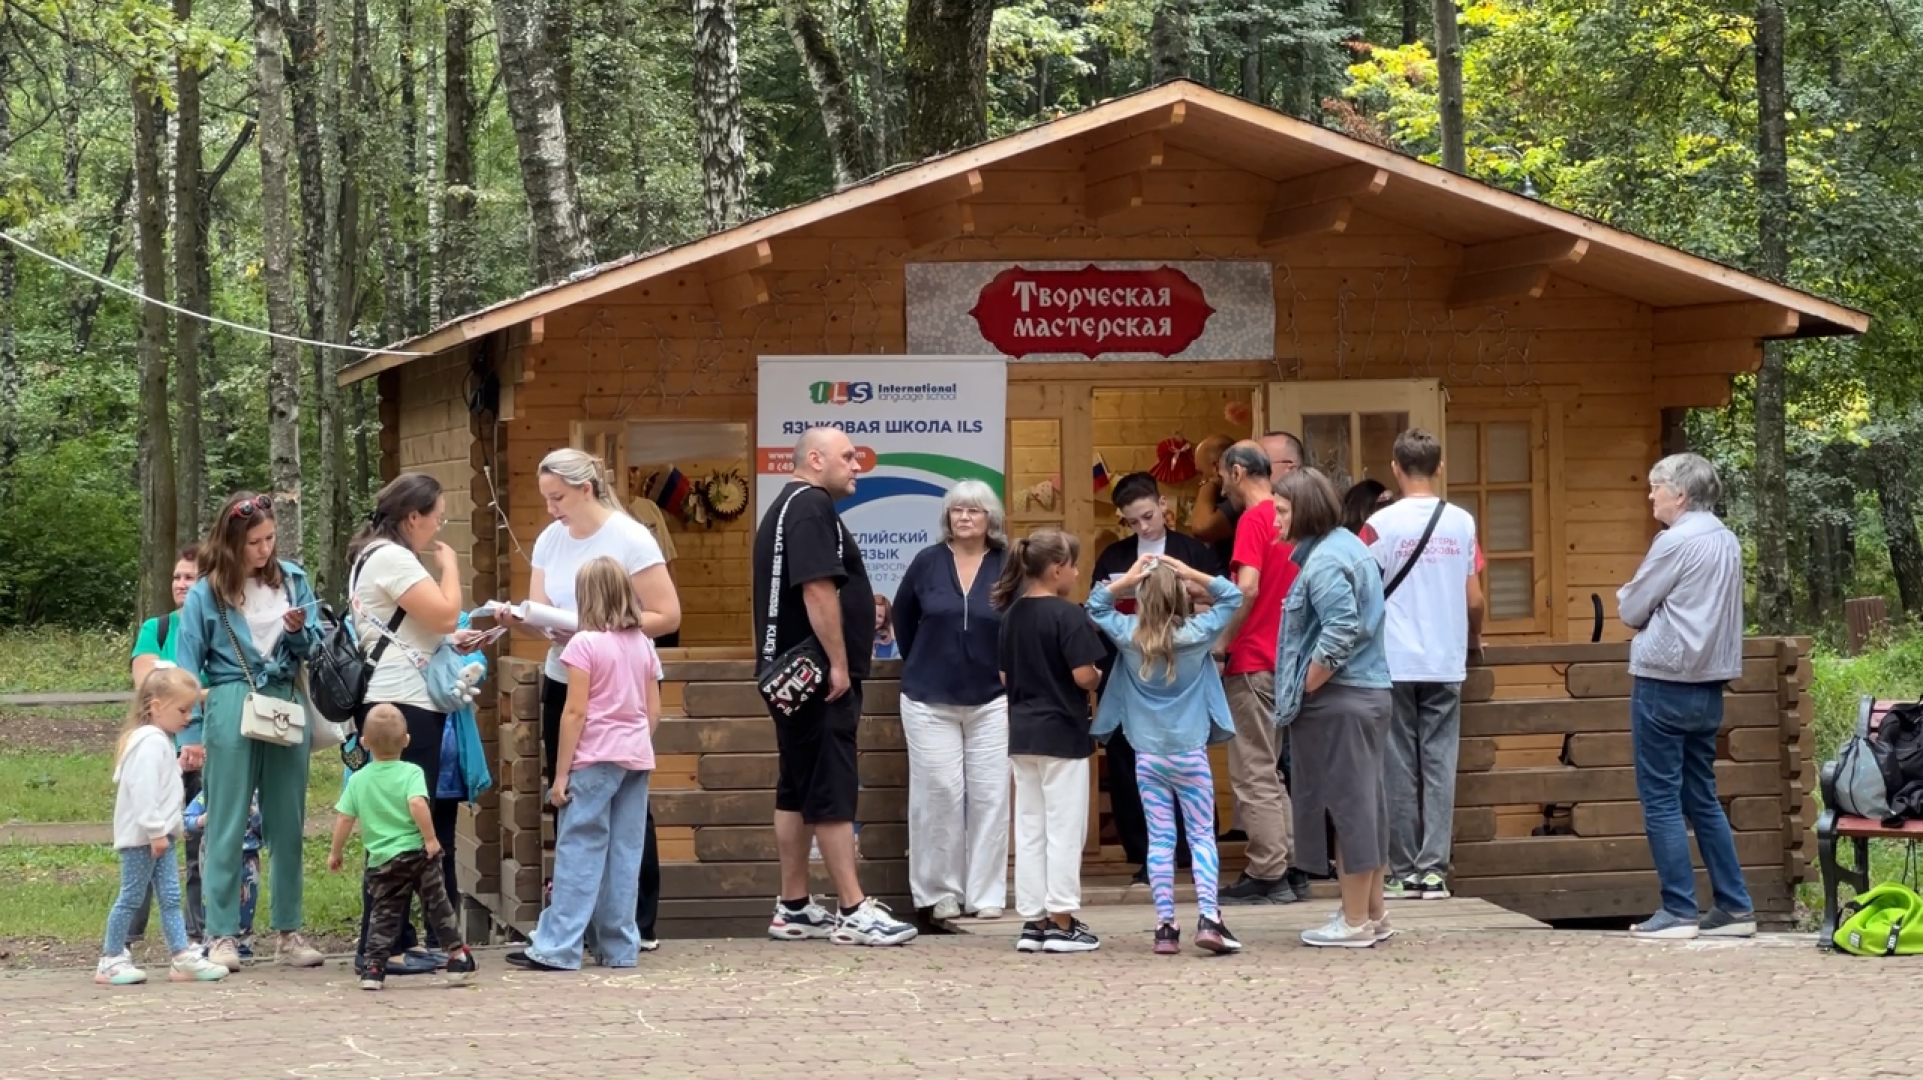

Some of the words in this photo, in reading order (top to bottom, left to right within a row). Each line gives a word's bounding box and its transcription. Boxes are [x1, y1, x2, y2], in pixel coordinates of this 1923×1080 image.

[816, 382, 870, 403] ILS
[878, 383, 957, 393] International
[878, 393, 924, 404] language
[926, 393, 957, 401] school
[885, 420, 952, 434] ШКОЛА
[957, 420, 983, 433] ILS
[776, 462, 795, 472] (49
[860, 548, 900, 560] ЯЗЫК
[776, 664, 814, 702] FILA
